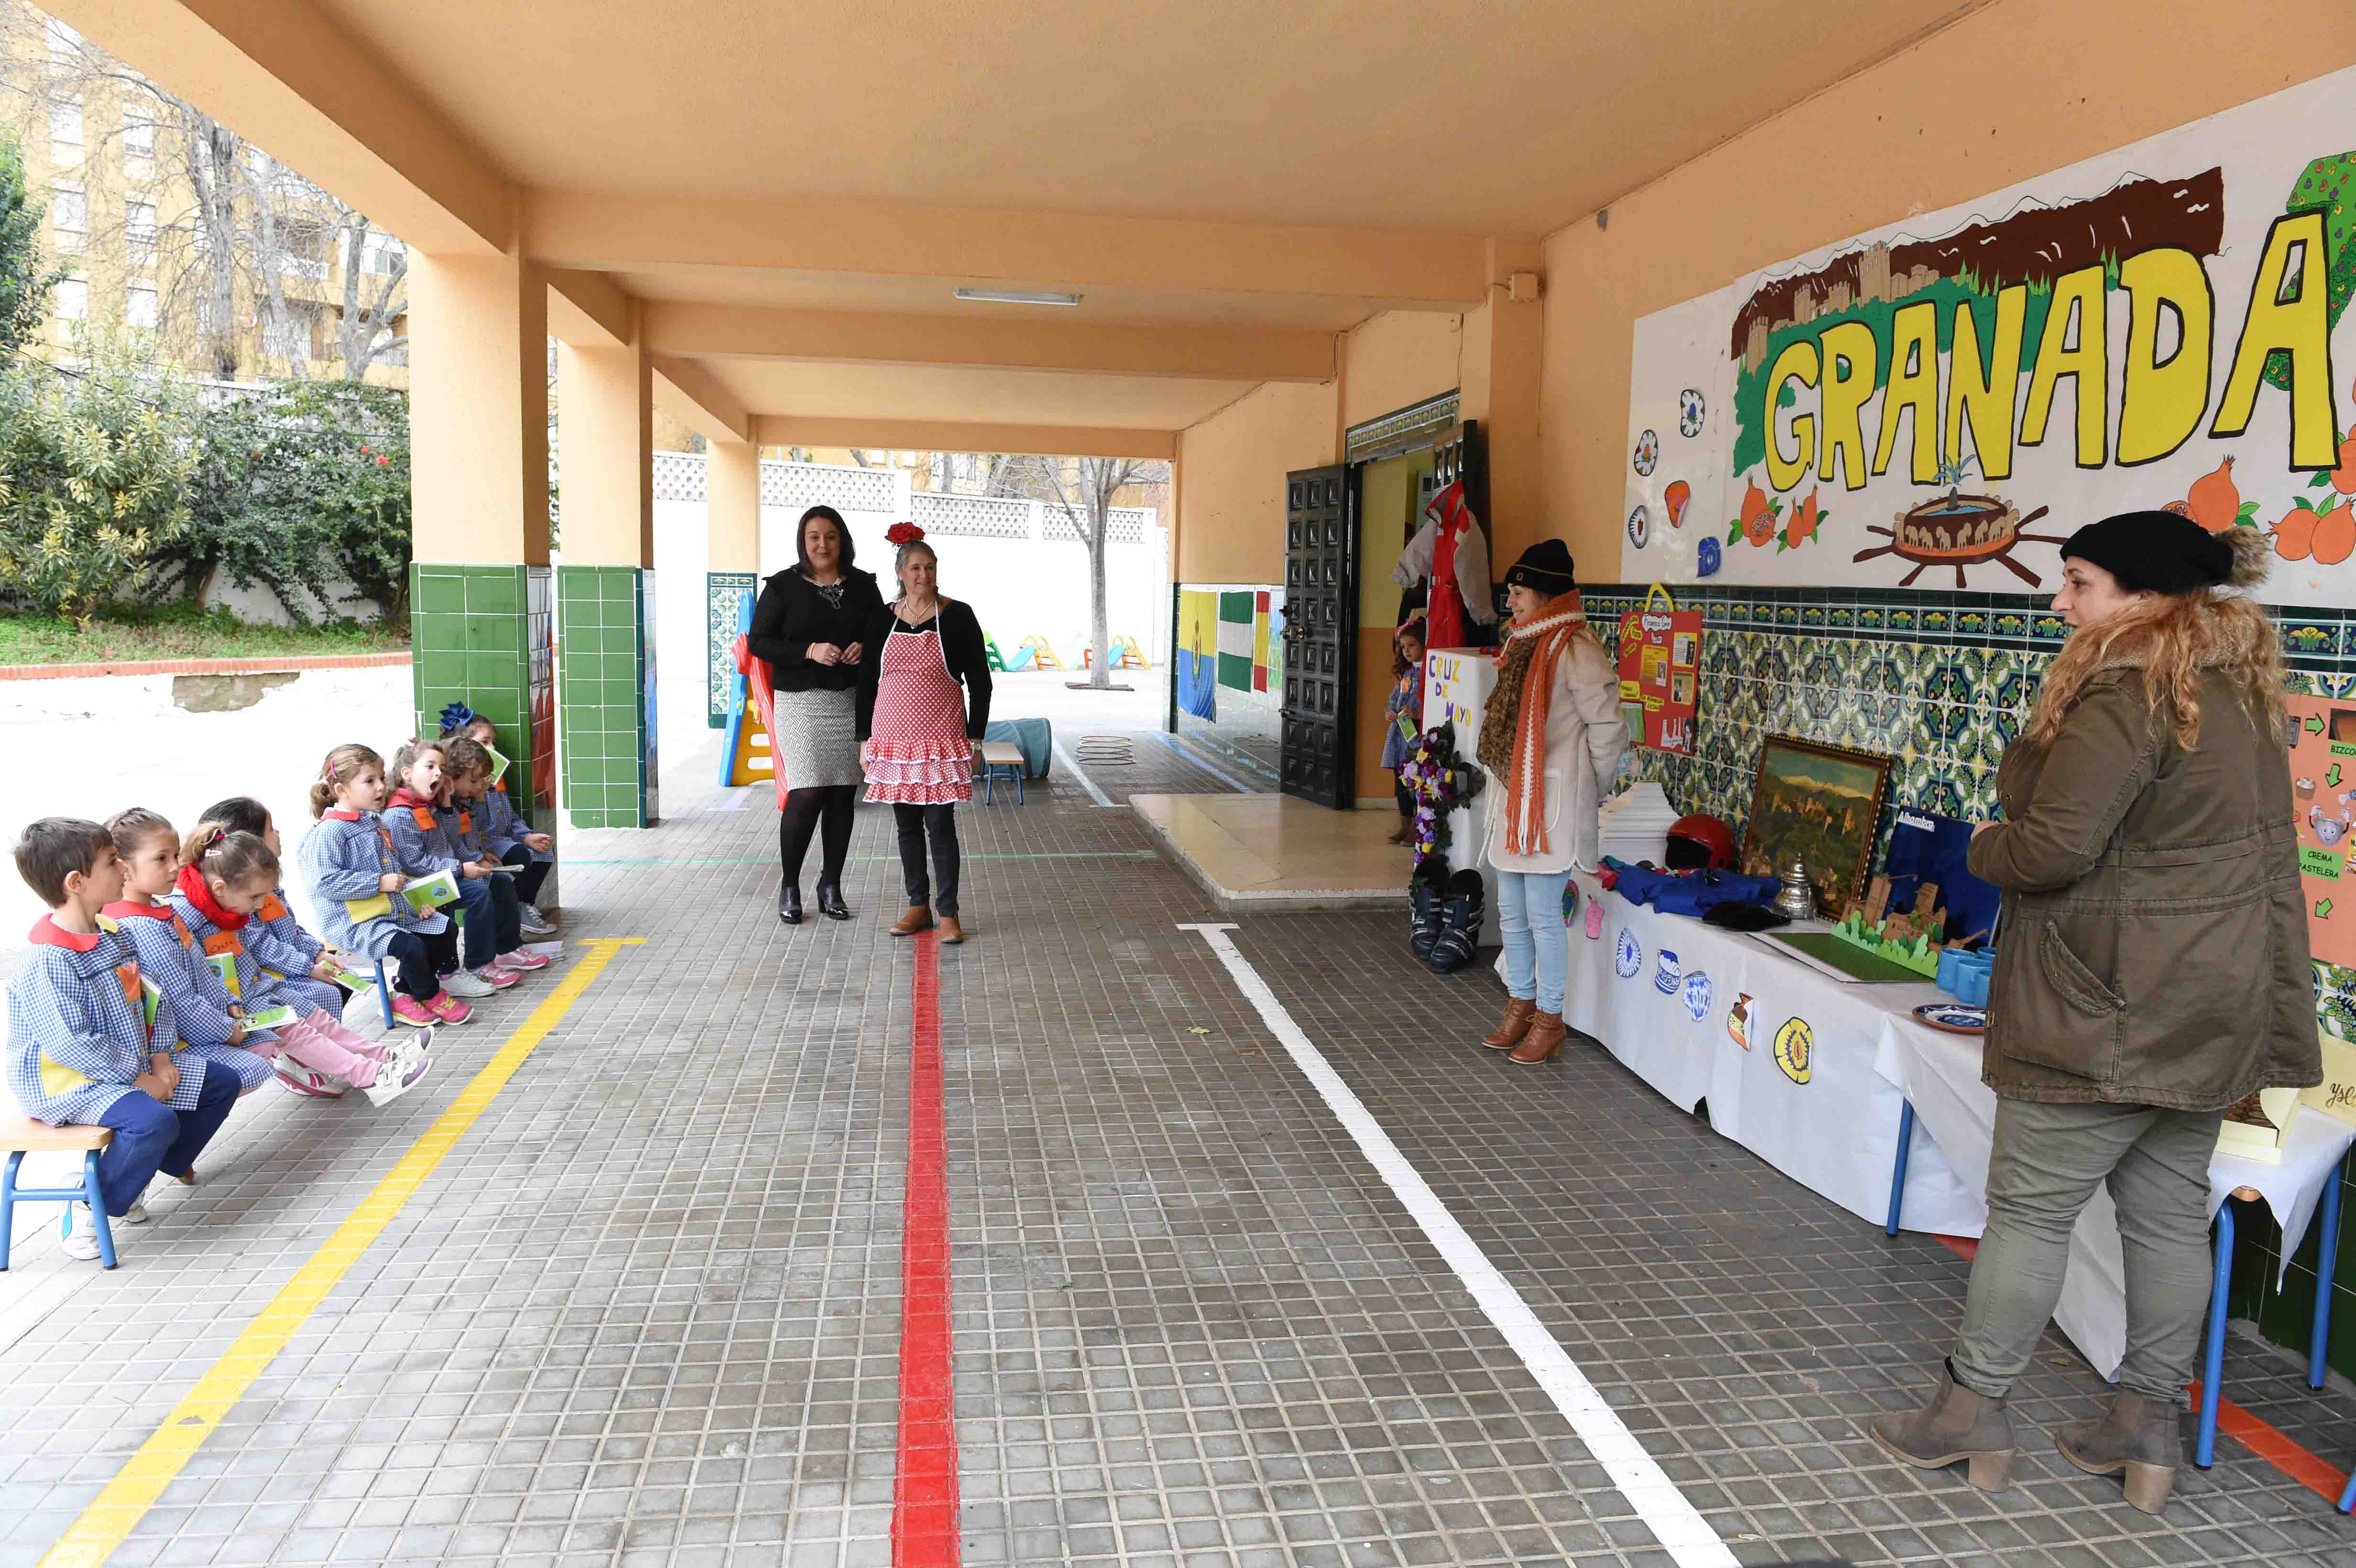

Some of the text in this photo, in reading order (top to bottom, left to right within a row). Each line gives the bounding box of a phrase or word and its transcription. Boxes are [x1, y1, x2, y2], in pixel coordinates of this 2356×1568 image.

[1764, 208, 2342, 491] GRANADA
[1429, 655, 1461, 683] CRUZ
[1436, 682, 1449, 699] DE
[1446, 701, 1472, 727] MAYO
[2308, 851, 2332, 863] CREMA
